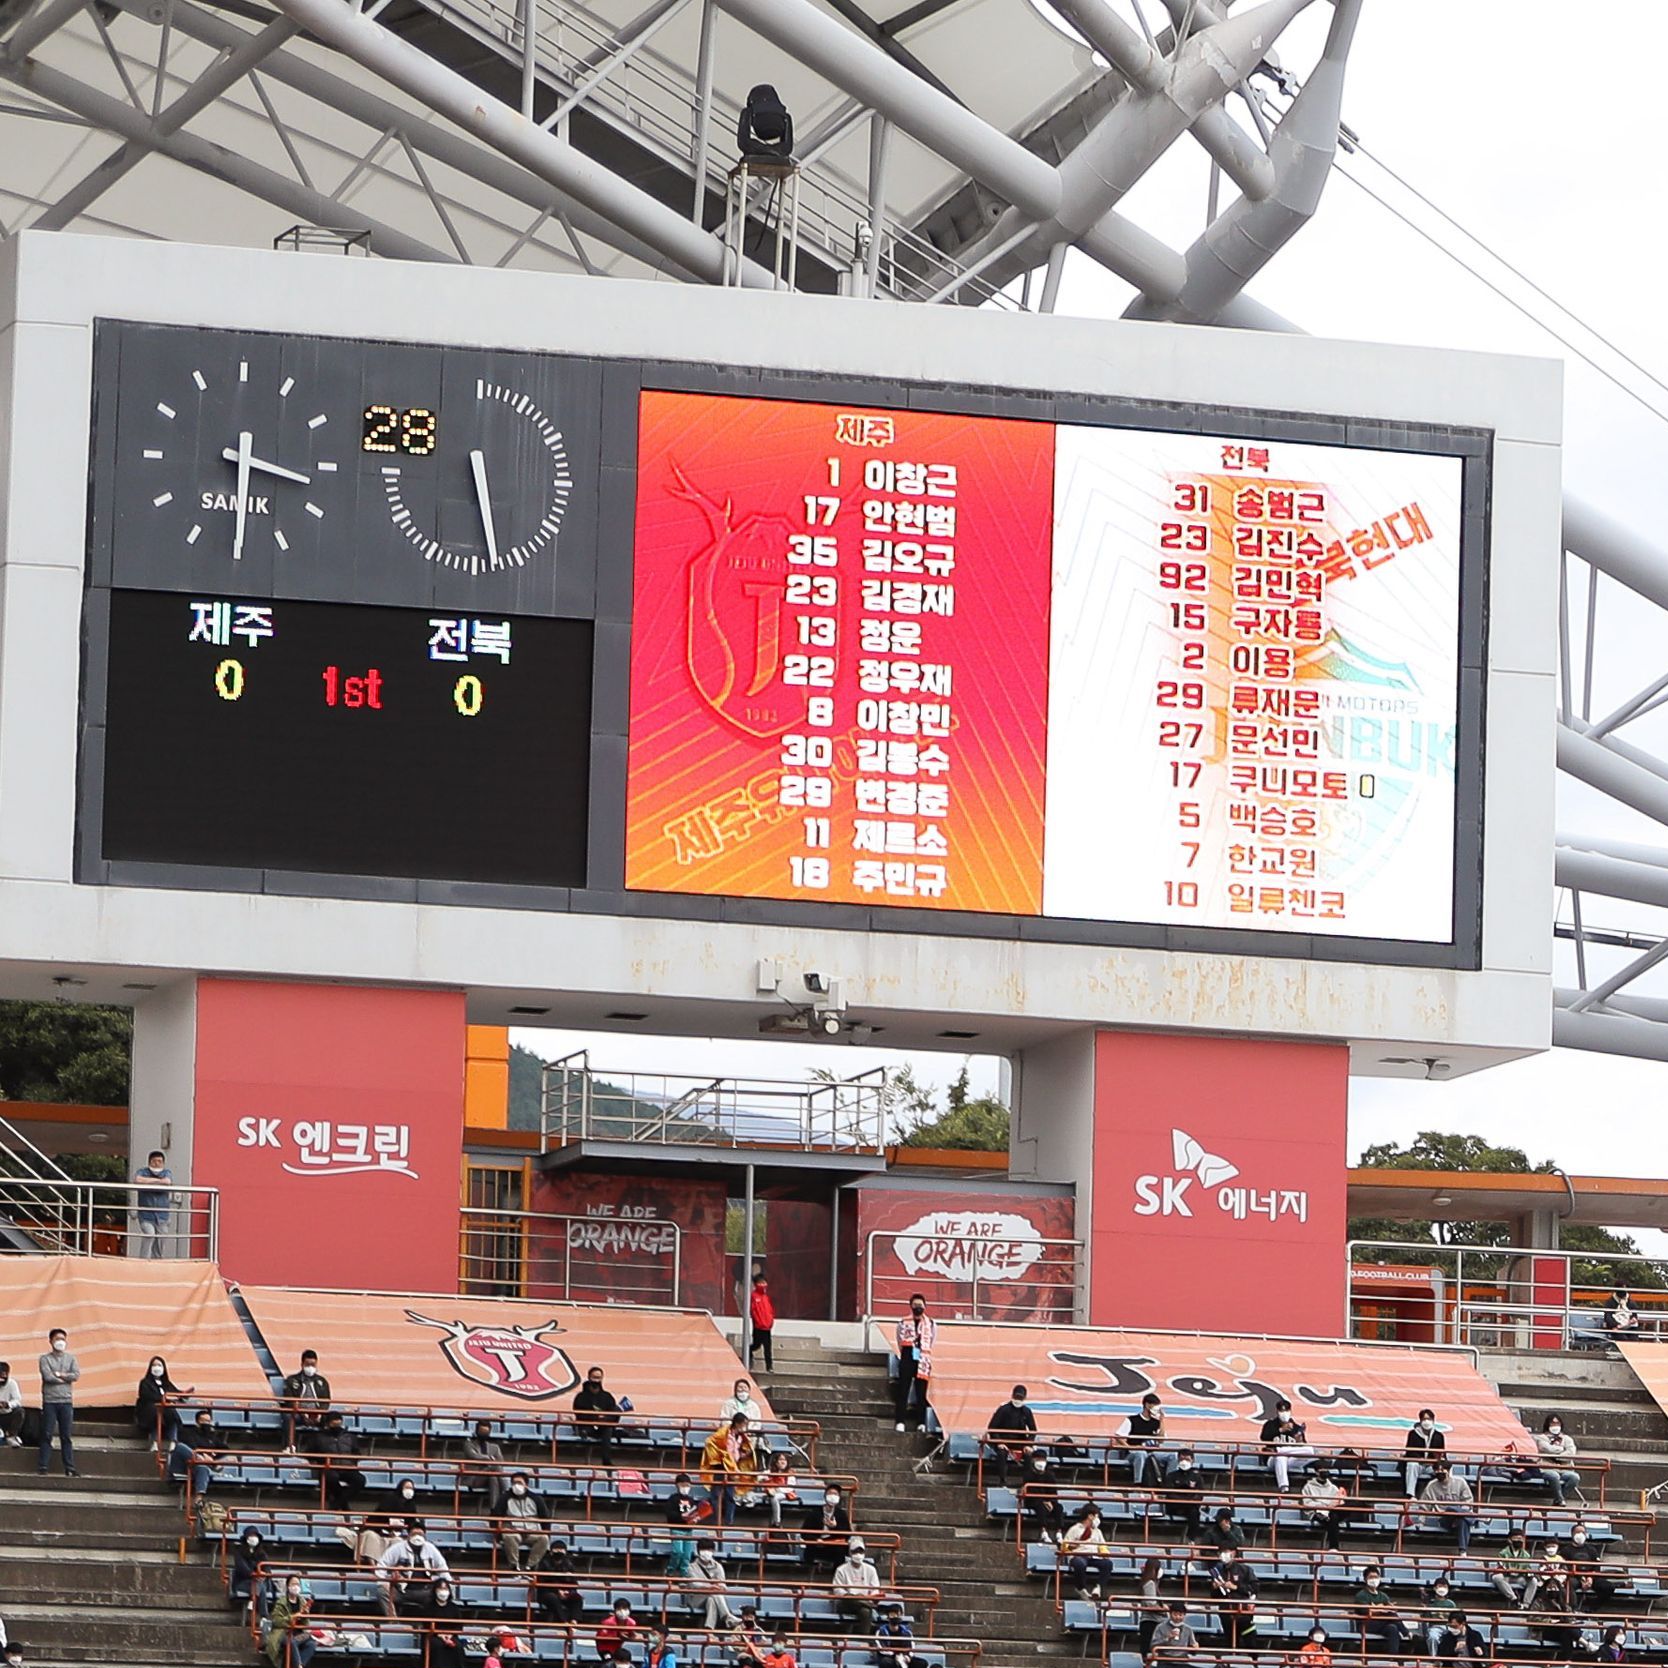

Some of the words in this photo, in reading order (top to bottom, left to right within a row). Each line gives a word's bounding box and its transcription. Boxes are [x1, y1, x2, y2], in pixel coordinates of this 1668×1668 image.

[362, 405, 436, 455] 28
[835, 414, 894, 447] 제주
[827, 457, 839, 487] 1
[864, 460, 957, 498] 이창근
[1220, 445, 1270, 472] 전북
[804, 496, 840, 525] 17
[863, 500, 955, 538] 안현범
[1174, 484, 1208, 512] 31
[1236, 489, 1325, 521] 송범근
[787, 534, 838, 567] 35
[862, 539, 955, 577] 김오규
[1160, 523, 1207, 551] 23
[1235, 528, 1324, 562] 김진수
[785, 575, 838, 606] 23
[861, 579, 954, 616] 김경재
[1160, 562, 1206, 591] 92
[1235, 567, 1322, 601] 김민혁
[189, 602, 273, 647] 제주
[797, 616, 836, 646] 13
[859, 619, 922, 655] 정운
[1170, 602, 1205, 630] 15
[1233, 606, 1322, 640] 구자룡
[428, 620, 512, 664] 전북
[1183, 643, 1204, 670] 2
[1233, 646, 1290, 676] 이용
[215, 660, 243, 701] 0
[322, 666, 382, 710] 1st
[454, 675, 484, 716] 0
[783, 655, 835, 687] 22
[858, 659, 952, 697] 정우재
[808, 697, 834, 727] 8
[857, 699, 950, 737] 이창민
[1156, 681, 1203, 709] 29
[1231, 686, 1320, 718] 류재문
[781, 734, 832, 767] 30
[856, 739, 949, 776] 김봉수
[1159, 722, 1203, 748] 27
[1231, 725, 1318, 758] 문선민
[779, 775, 832, 808] 29
[856, 779, 948, 817] 변경준
[1169, 762, 1202, 788] 17
[1230, 765, 1348, 800] 쿠니모토
[804, 818, 830, 848] 11
[852, 819, 948, 856] 제르소
[1179, 802, 1200, 828] 5
[1229, 804, 1317, 837] 백승호
[790, 856, 829, 889] 18
[852, 860, 947, 897] 주민규
[1181, 842, 1200, 867] 7
[1229, 844, 1316, 878] 한교원
[1164, 881, 1198, 907] 10
[1227, 883, 1346, 918] 일류첸코
[237, 1115, 282, 1149] SK
[292, 1120, 410, 1170] 엔크린
[586, 1203, 615, 1216] WE
[1133, 1175, 1193, 1218] SK
[1217, 1185, 1309, 1224] 에너지
[569, 1222, 675, 1255] ORANGE
[934, 1219, 962, 1236] WE
[966, 1222, 1003, 1238] ARE
[914, 1239, 1023, 1270] ORANGE
